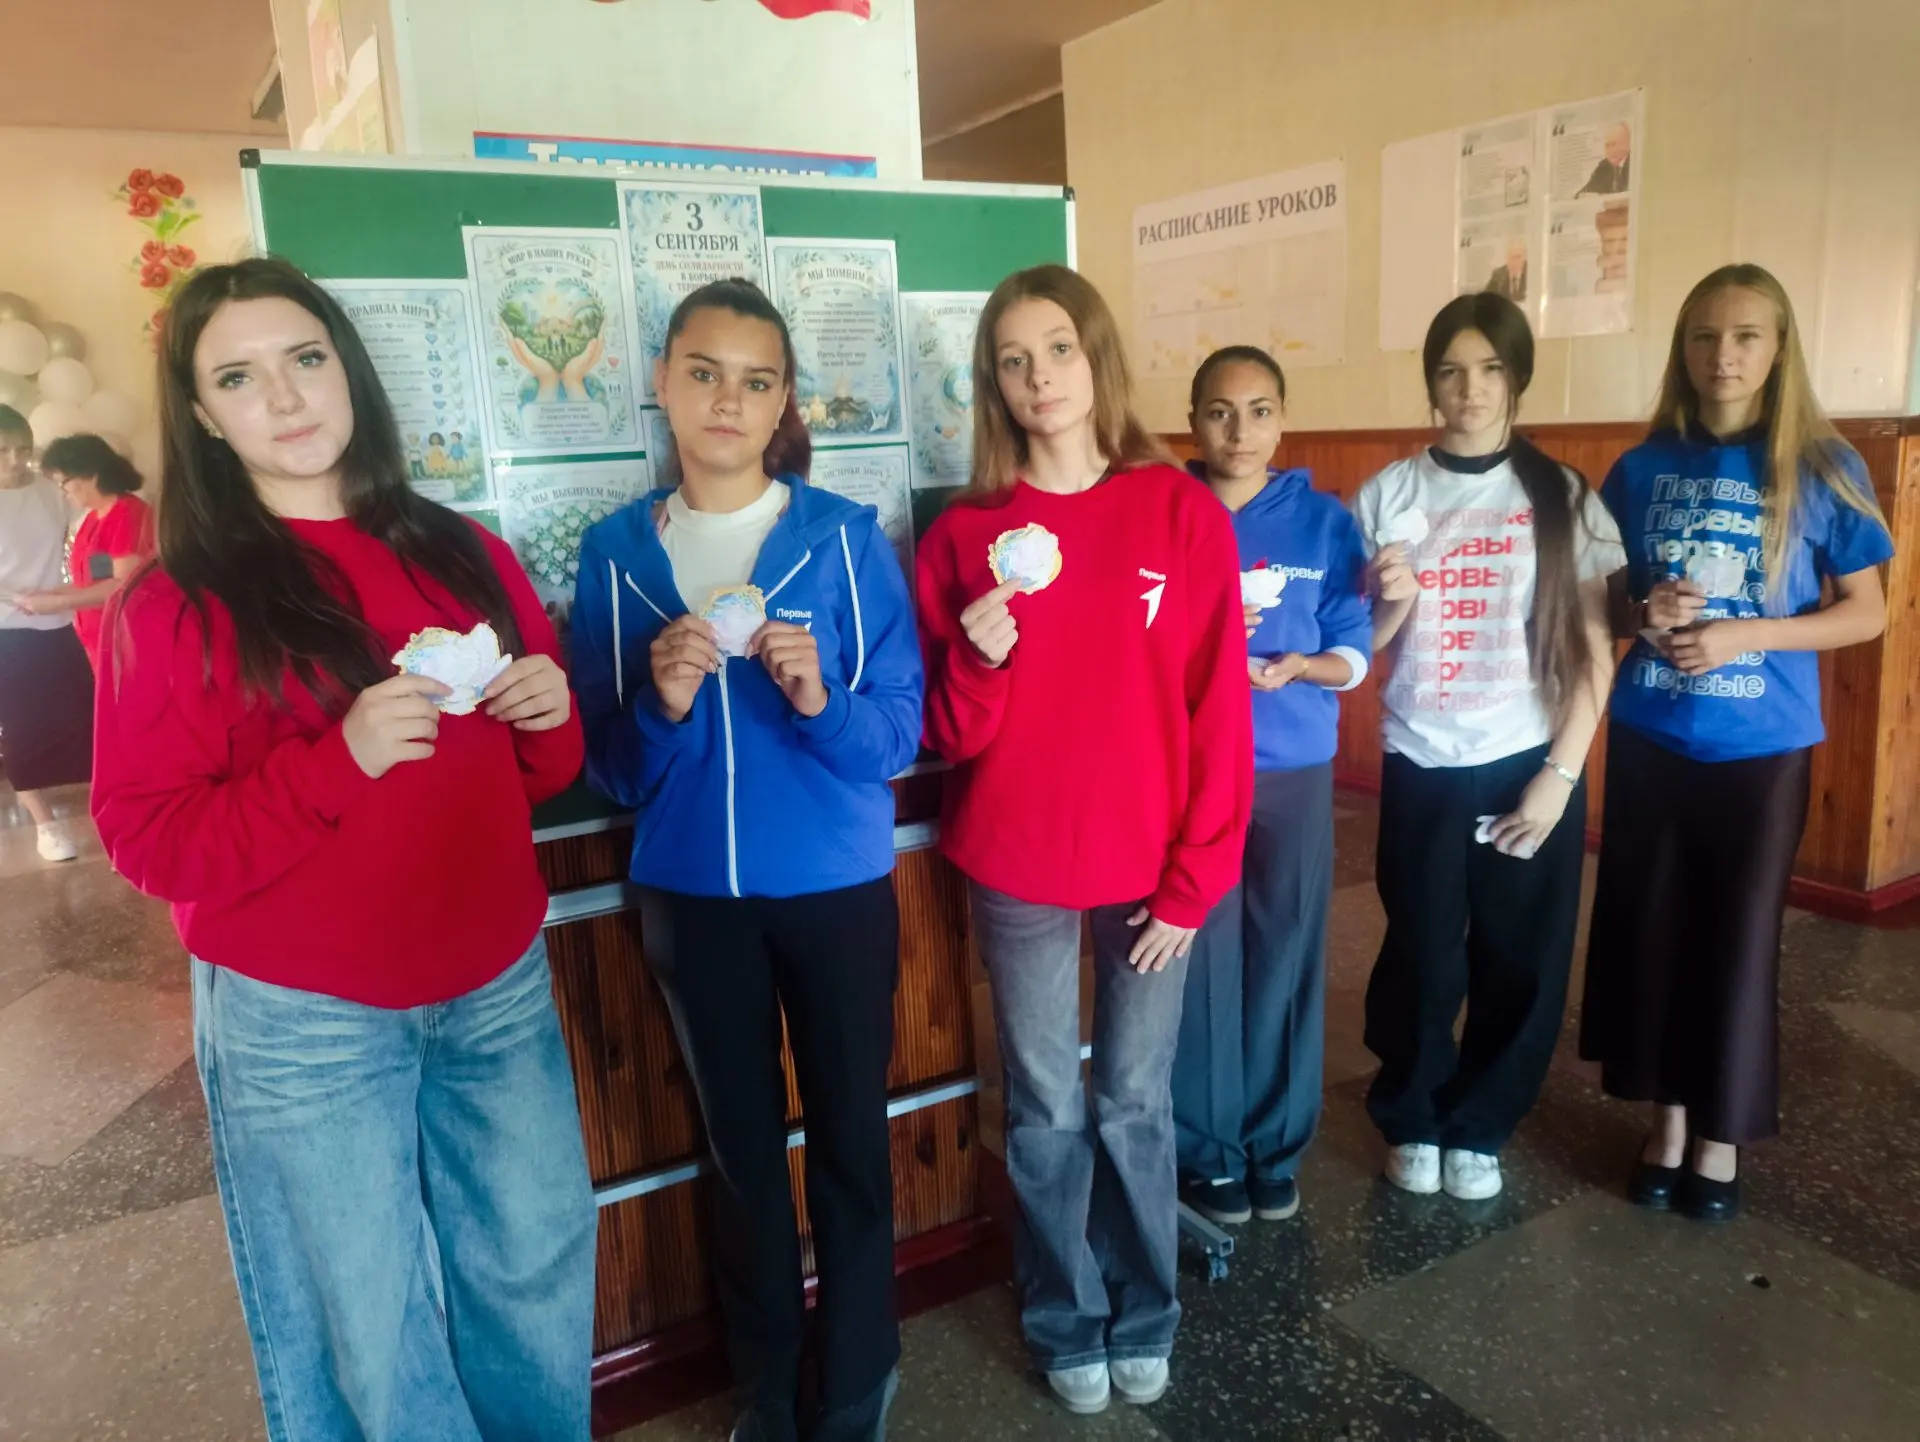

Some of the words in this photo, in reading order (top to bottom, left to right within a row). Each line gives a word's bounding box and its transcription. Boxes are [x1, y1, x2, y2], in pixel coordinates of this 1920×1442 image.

[686, 202, 704, 232] 3
[1138, 202, 1250, 246] РАСПИСАНИЕ
[1257, 183, 1338, 222] УРОКОВ
[655, 232, 739, 252] СЕНТЯБРЯ
[807, 270, 824, 282] МЫ
[826, 267, 866, 283] ПОМНИМ
[401, 303, 431, 319] МИРА
[531, 491, 549, 504] МЫ
[552, 485, 604, 500] ВЫБИРАЕМ
[1651, 474, 1770, 508] Первы
[776, 607, 813, 621] Первые
